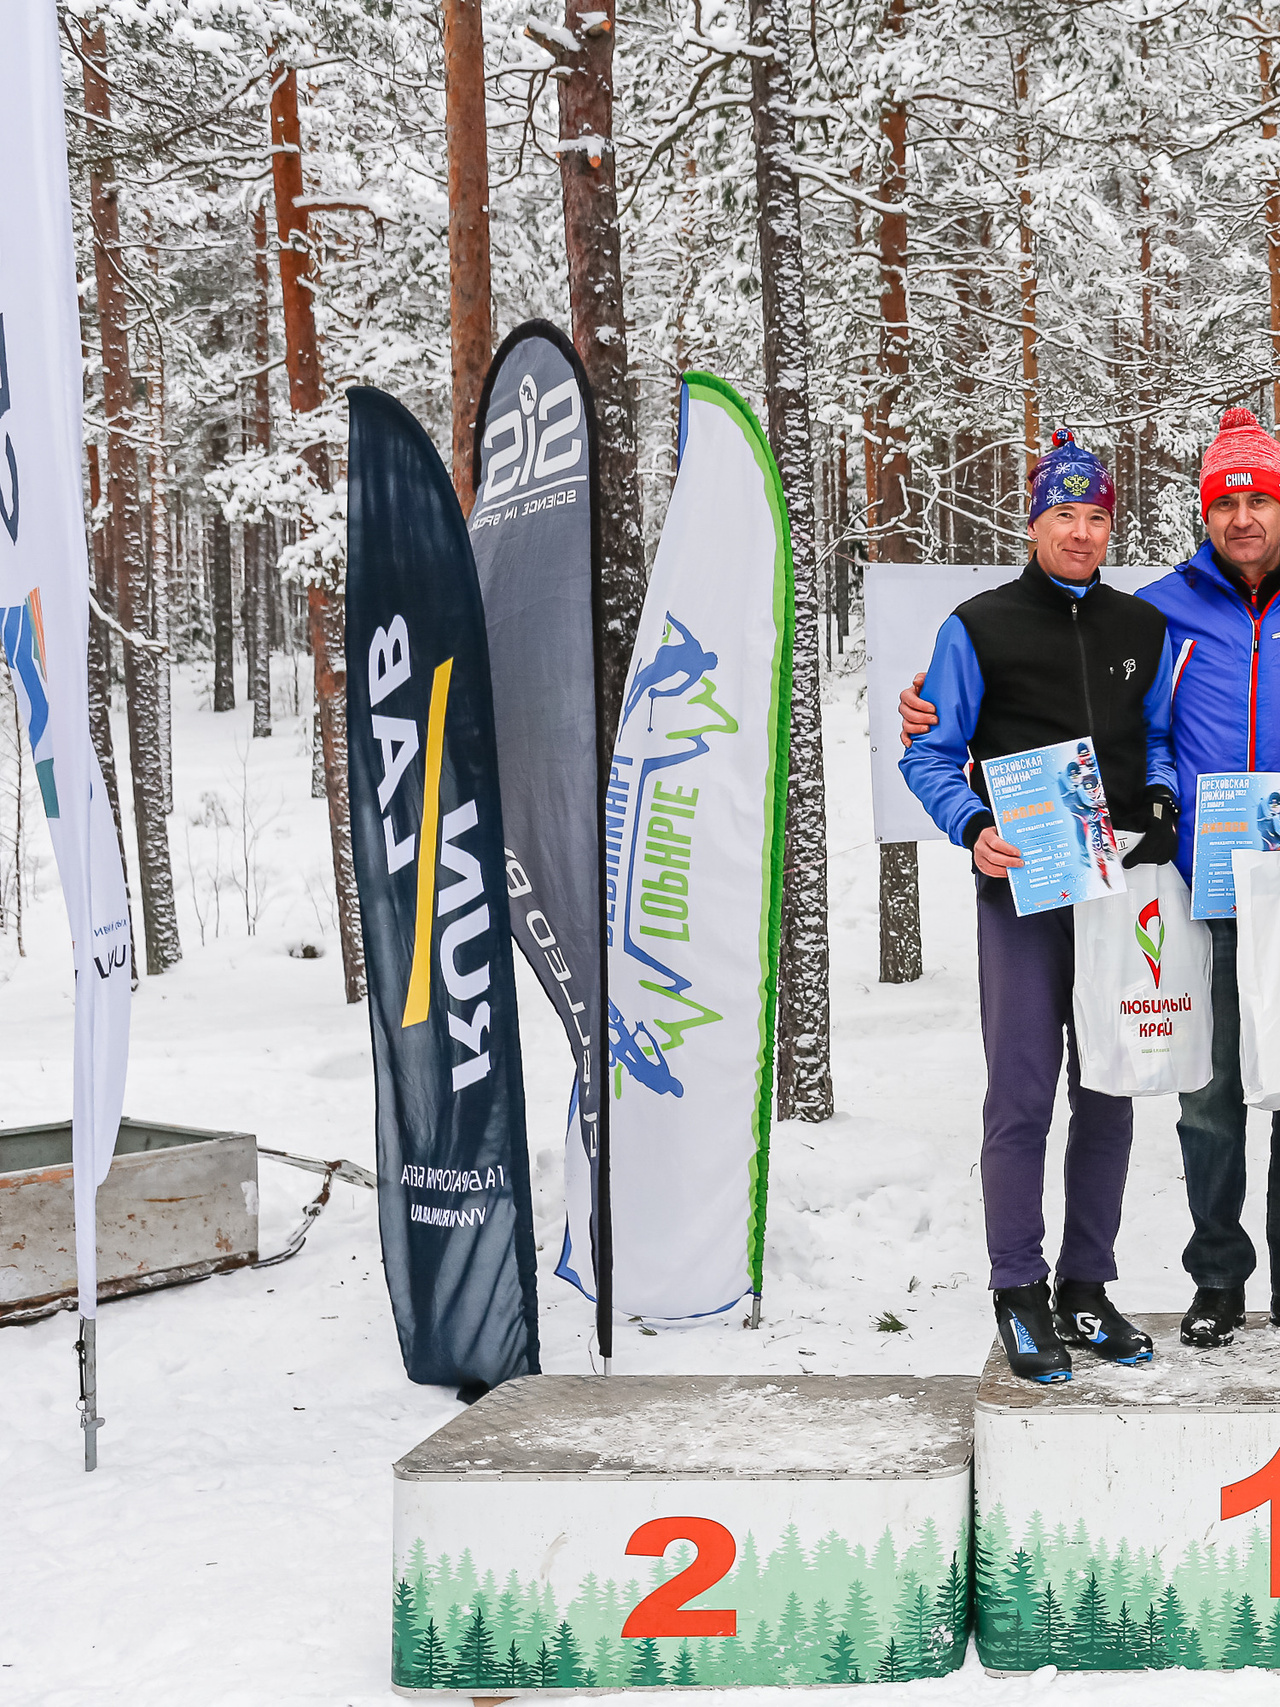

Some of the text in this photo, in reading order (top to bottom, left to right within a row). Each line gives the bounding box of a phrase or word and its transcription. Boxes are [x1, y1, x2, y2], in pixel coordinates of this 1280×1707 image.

[1225, 472, 1254, 487] CHINA
[988, 755, 1044, 777] ОРЕХОВСКАЯ
[991, 769, 1032, 790] ДЮЖИНА
[1201, 779, 1250, 790] ОРЕХОВСКАЯ
[1201, 790, 1236, 801] ДЮЖИНА
[1002, 801, 1056, 824] ДИПЛОМ
[1201, 822, 1249, 835] ДИПЛОМ
[1119, 993, 1192, 1015] ЛЮБИМЫЙ
[1139, 1018, 1173, 1037] КРАЙ
[621, 1517, 738, 1640] 2
